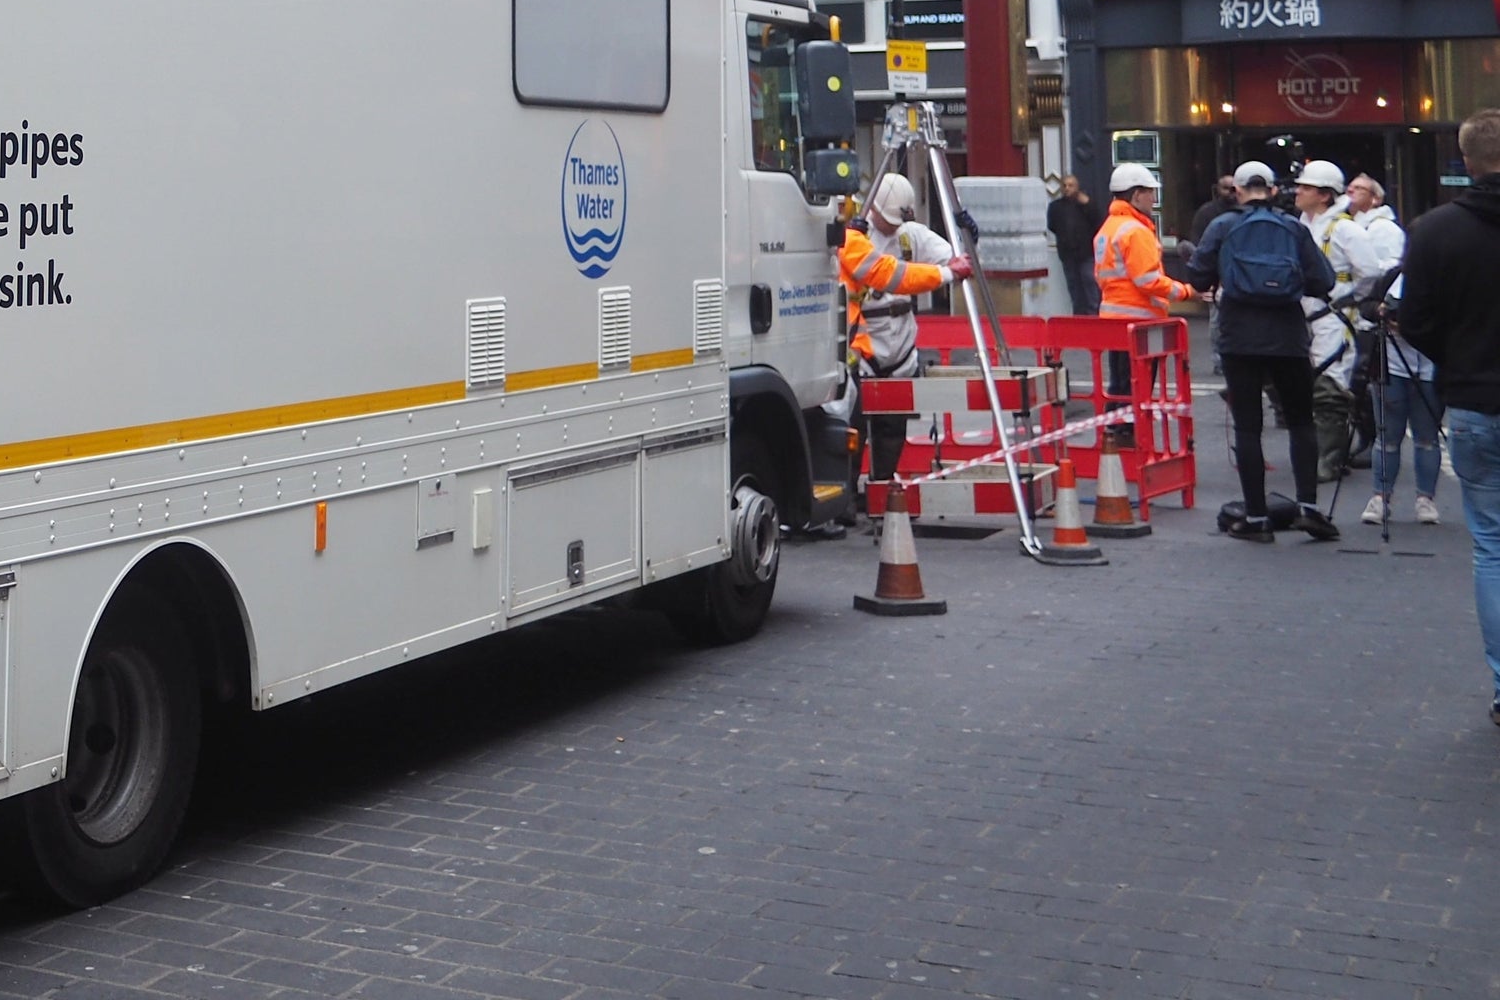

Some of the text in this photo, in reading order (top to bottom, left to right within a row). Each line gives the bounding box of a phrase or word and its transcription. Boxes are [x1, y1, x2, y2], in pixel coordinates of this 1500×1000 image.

[920, 14, 938, 24] AND
[1277, 77, 1361, 96] HOT POT
[0, 119, 84, 179] pipes
[570, 157, 619, 186] Thames
[576, 193, 615, 220] Water
[19, 194, 74, 250] put
